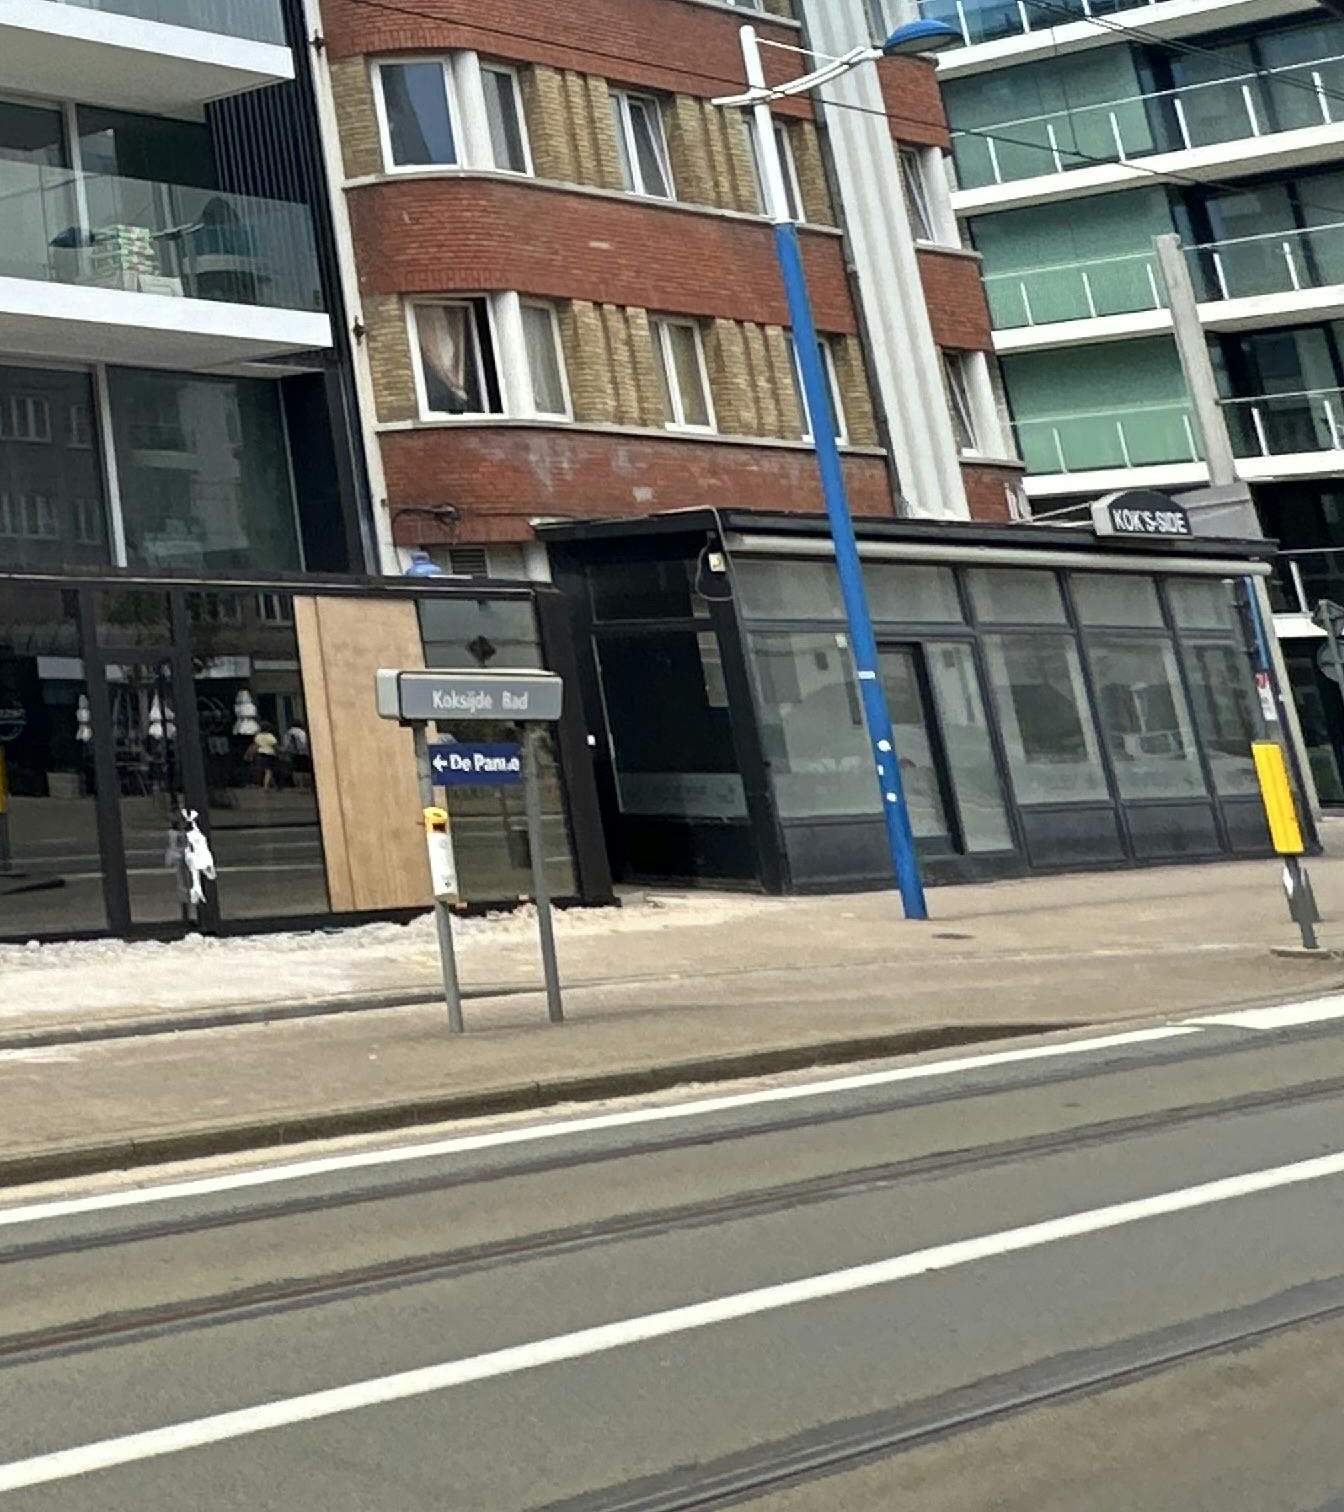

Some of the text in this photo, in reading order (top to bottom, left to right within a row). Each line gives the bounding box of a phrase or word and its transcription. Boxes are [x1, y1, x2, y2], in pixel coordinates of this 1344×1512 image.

[431, 689, 528, 713] Koksijde Bad
[448, 753, 472, 772] De
